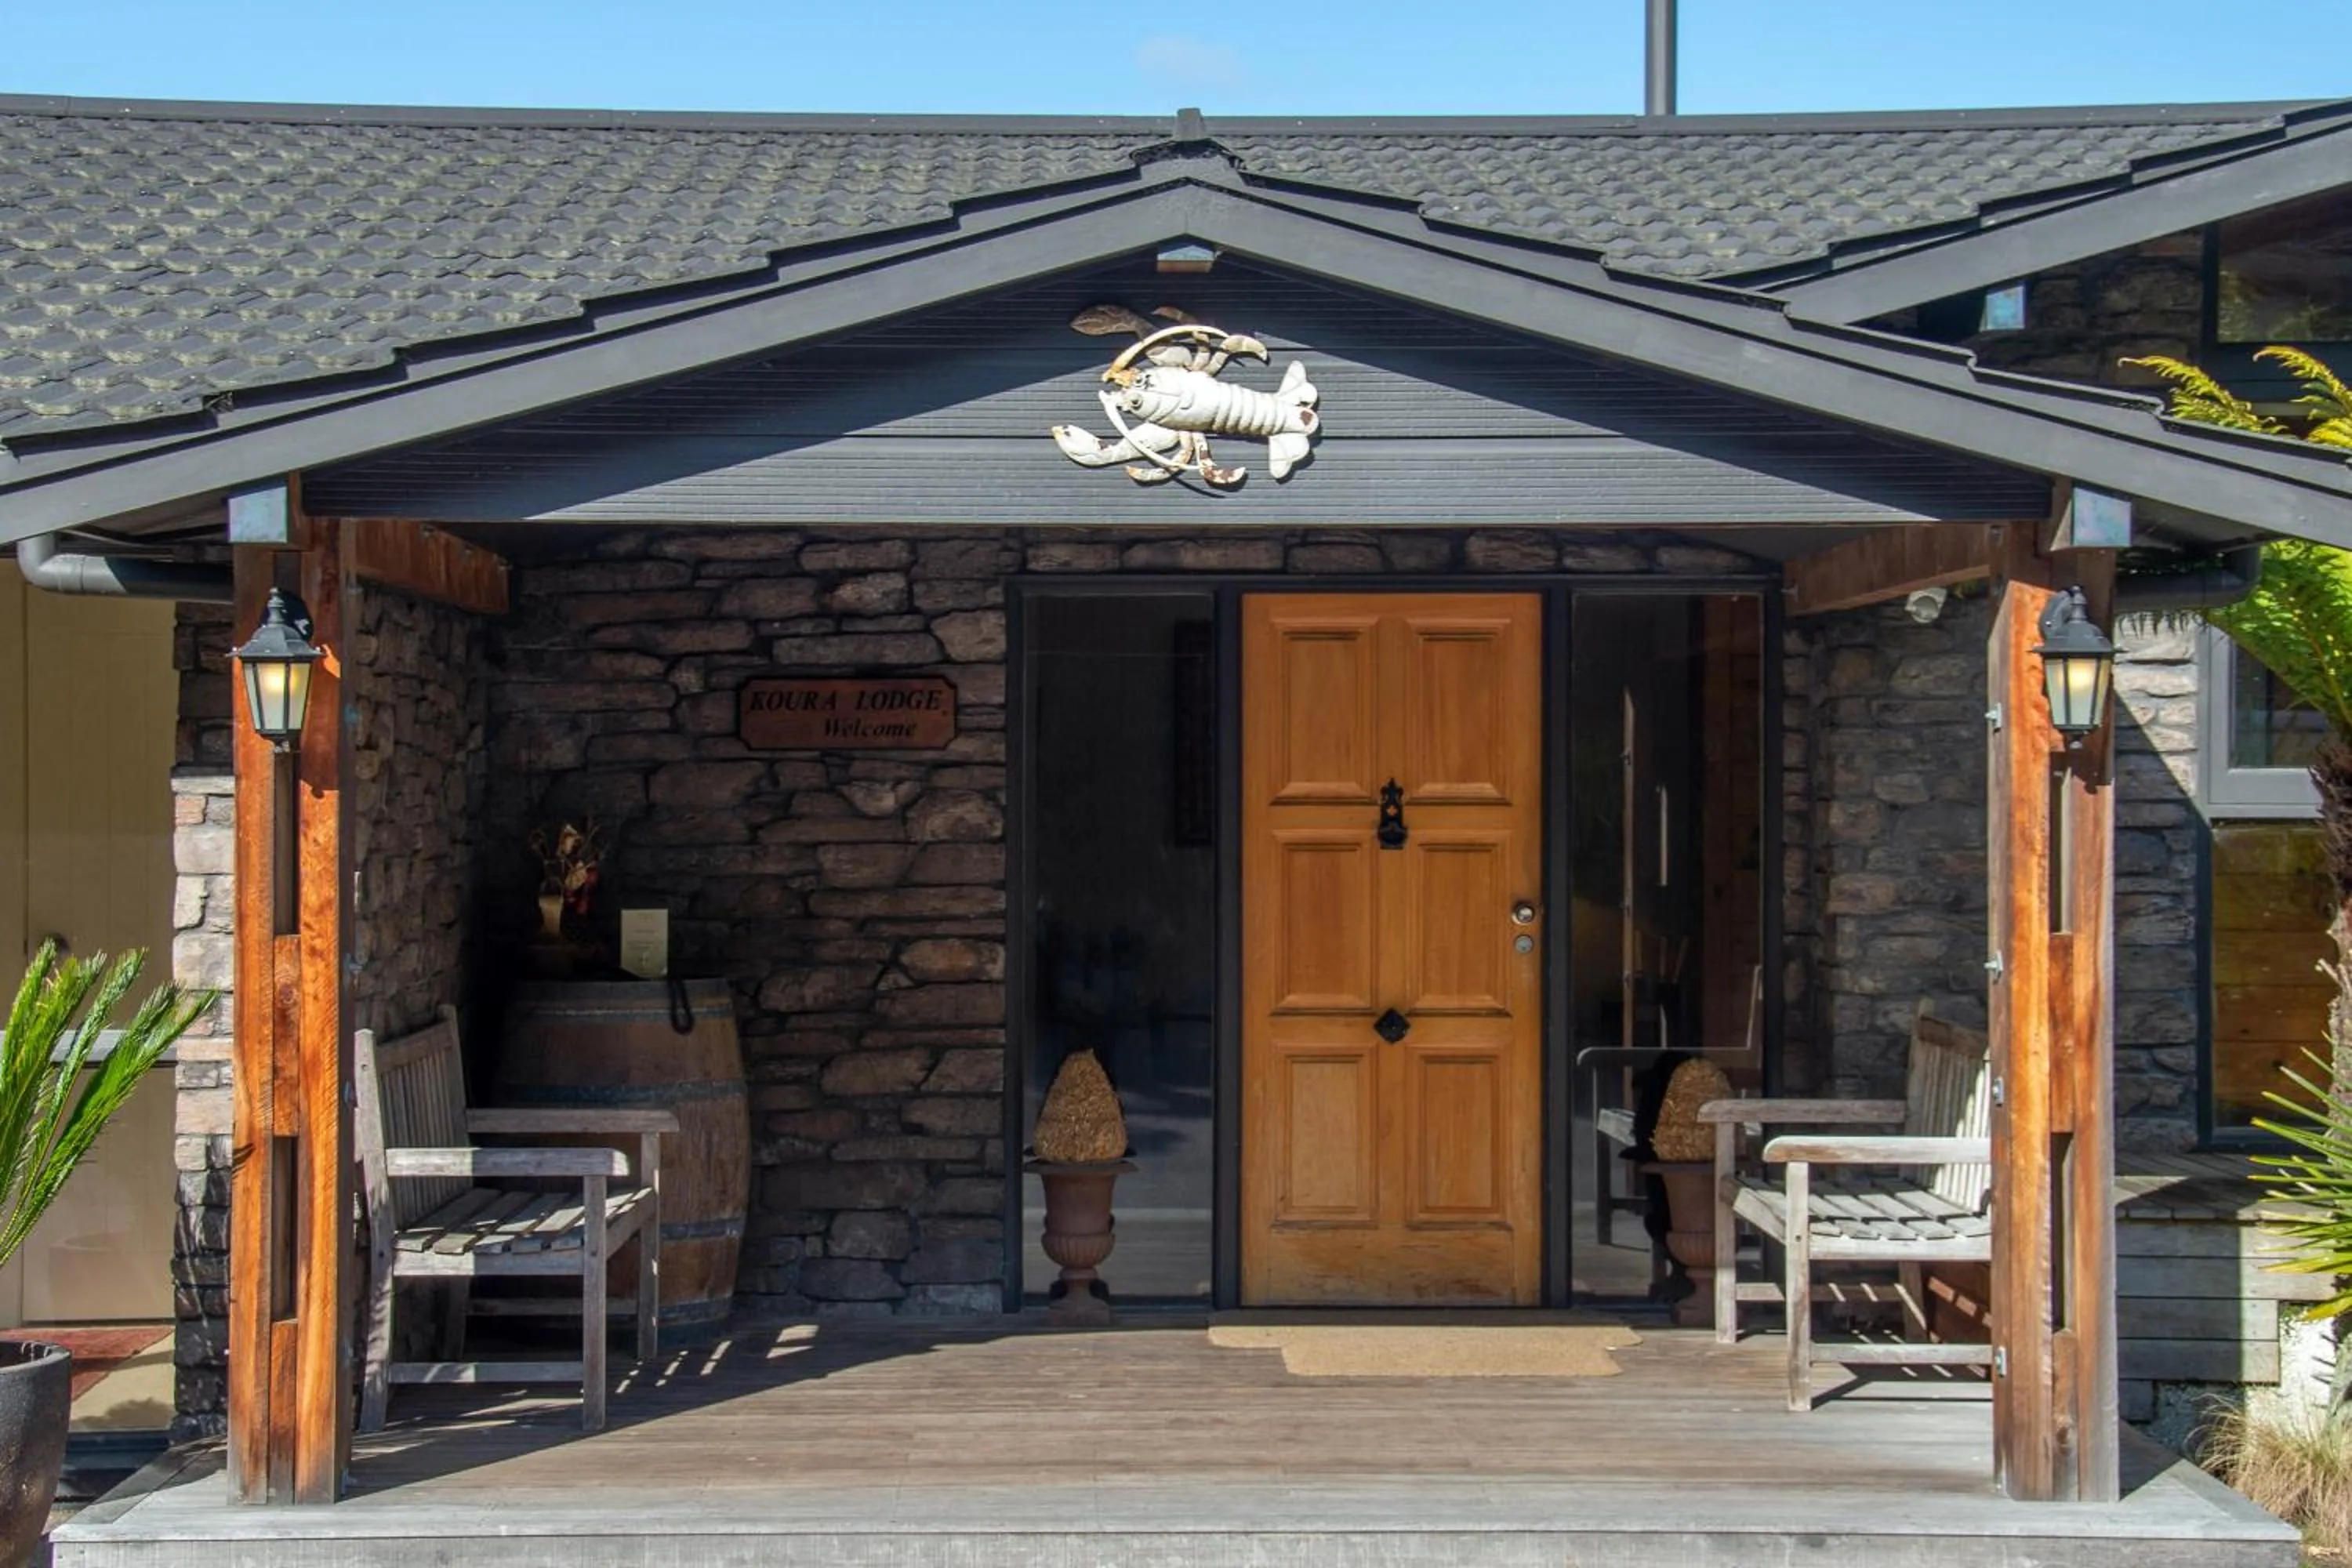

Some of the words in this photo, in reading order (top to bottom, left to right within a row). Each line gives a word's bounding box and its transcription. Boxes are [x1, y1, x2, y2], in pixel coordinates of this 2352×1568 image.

[750, 689, 837, 711] KOURA
[855, 688, 943, 711] LODGE
[824, 717, 917, 738] Welcome
